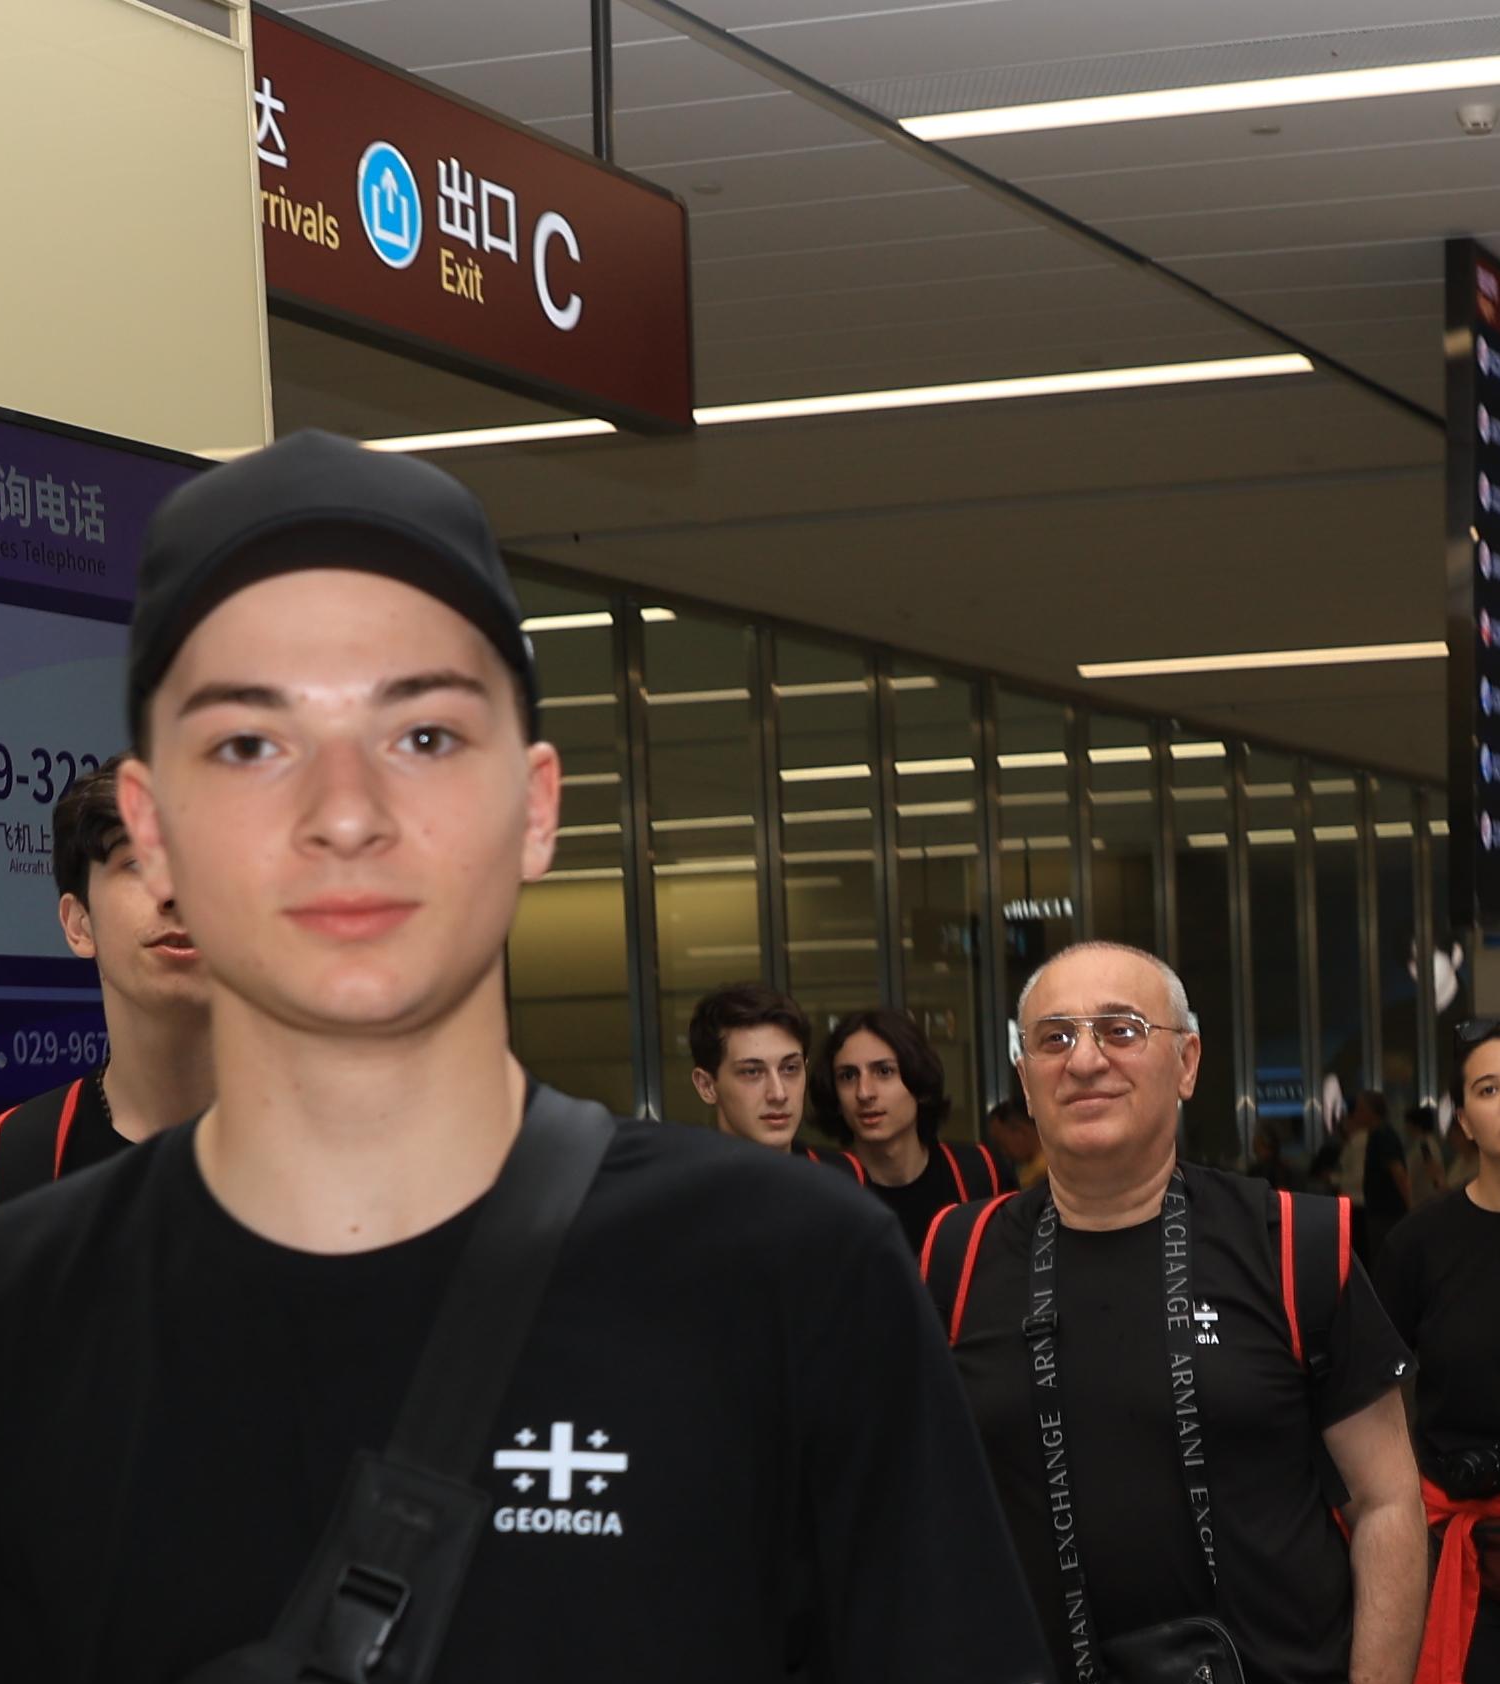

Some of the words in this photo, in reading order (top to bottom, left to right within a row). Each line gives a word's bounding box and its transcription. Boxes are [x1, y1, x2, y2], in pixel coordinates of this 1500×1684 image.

[437, 156, 518, 264] 出口
[440, 248, 485, 304] Exit
[532, 211, 583, 332] C
[21, 540, 106, 578] Telephone
[9, 858, 45, 874] Aircraft
[1164, 1191, 1193, 1331] EXCHANGE
[1171, 1353, 1205, 1467] ARMANI
[493, 1506, 623, 1537] GEORGIA
[1040, 1410, 1078, 1572] EXCHANGE
